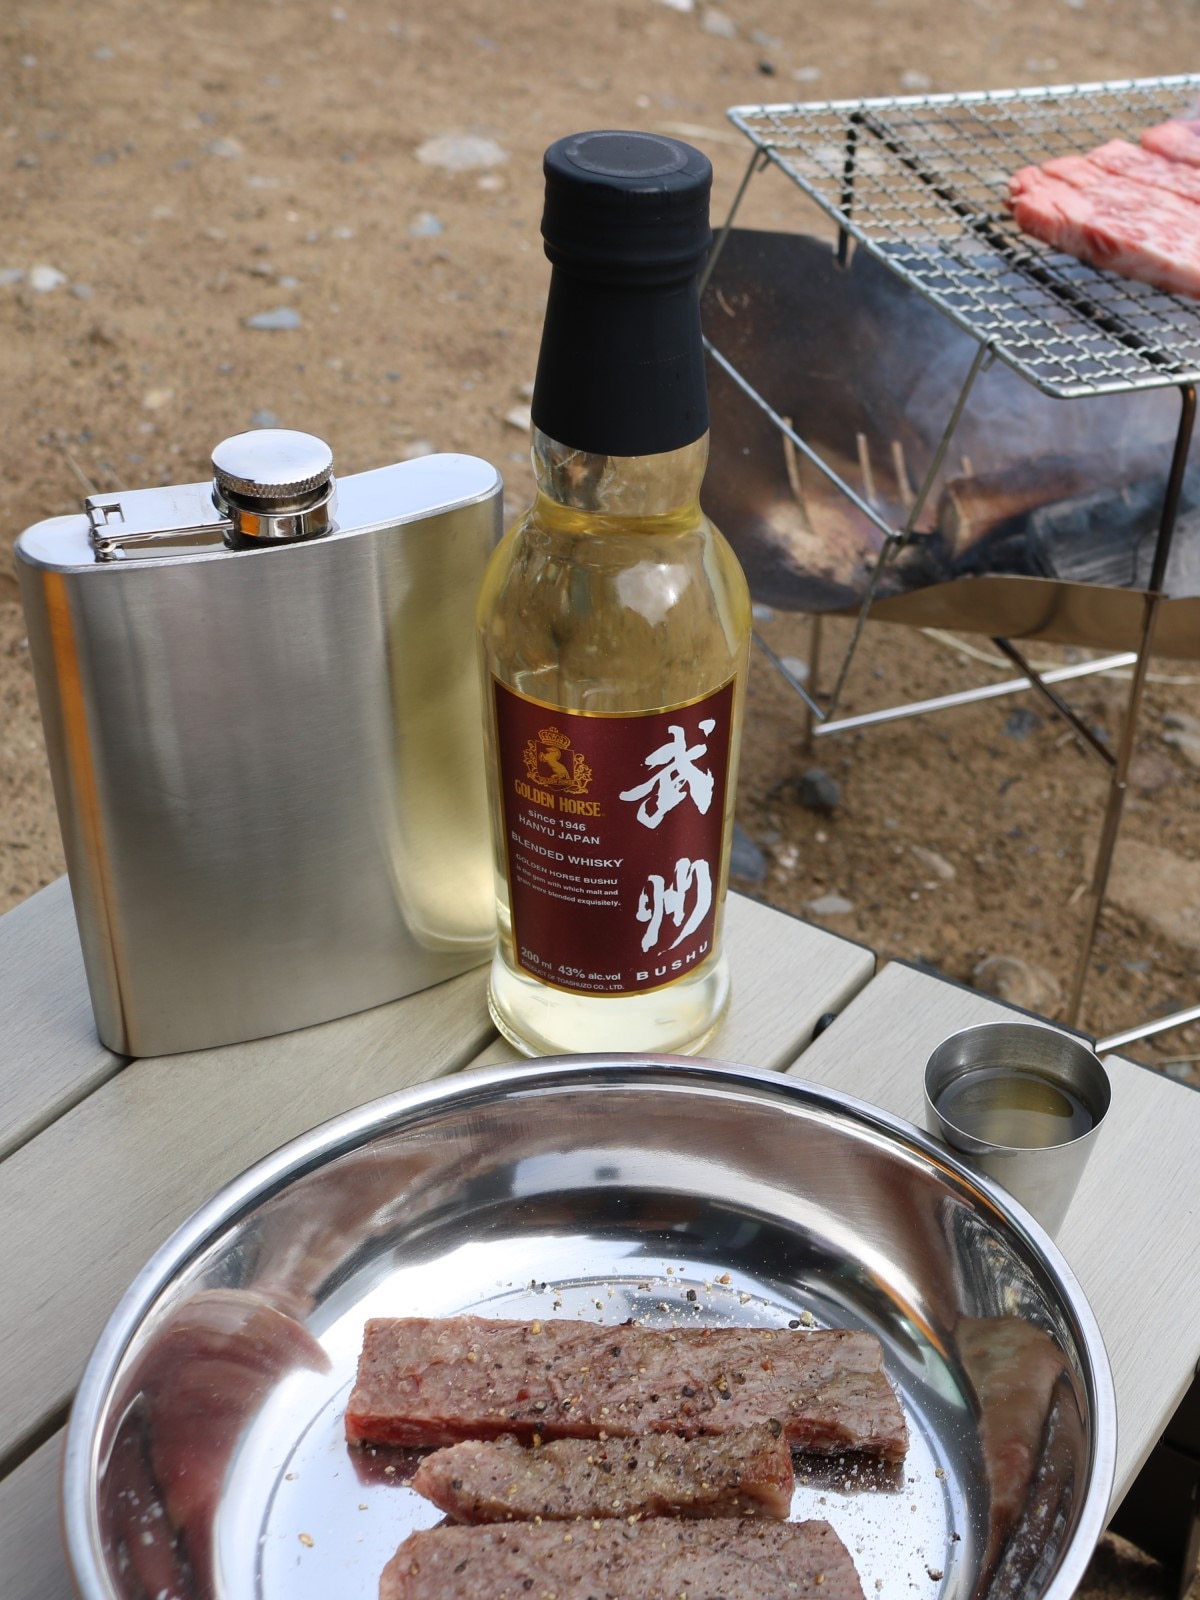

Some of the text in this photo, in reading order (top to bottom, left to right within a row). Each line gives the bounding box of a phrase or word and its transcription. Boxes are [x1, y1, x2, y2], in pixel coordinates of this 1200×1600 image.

[515, 780, 555, 809] GOLDEN
[560, 796, 601, 817] HORSE
[518, 813, 600, 845] HANYU JAPAN
[528, 809, 586, 832] since 1946
[511, 830, 624, 868] BLENDED WHISKY
[515, 853, 618, 885] GOLDEN HORSE BUSHU
[547, 881, 562, 889] with
[563, 885, 584, 894] which
[586, 888, 602, 896] malt
[547, 890, 576, 902] blended
[577, 898, 621, 907] exquisitely.
[521, 946, 621, 981] 200 ml 43% alc.vol
[636, 940, 709, 981] BUSHU
